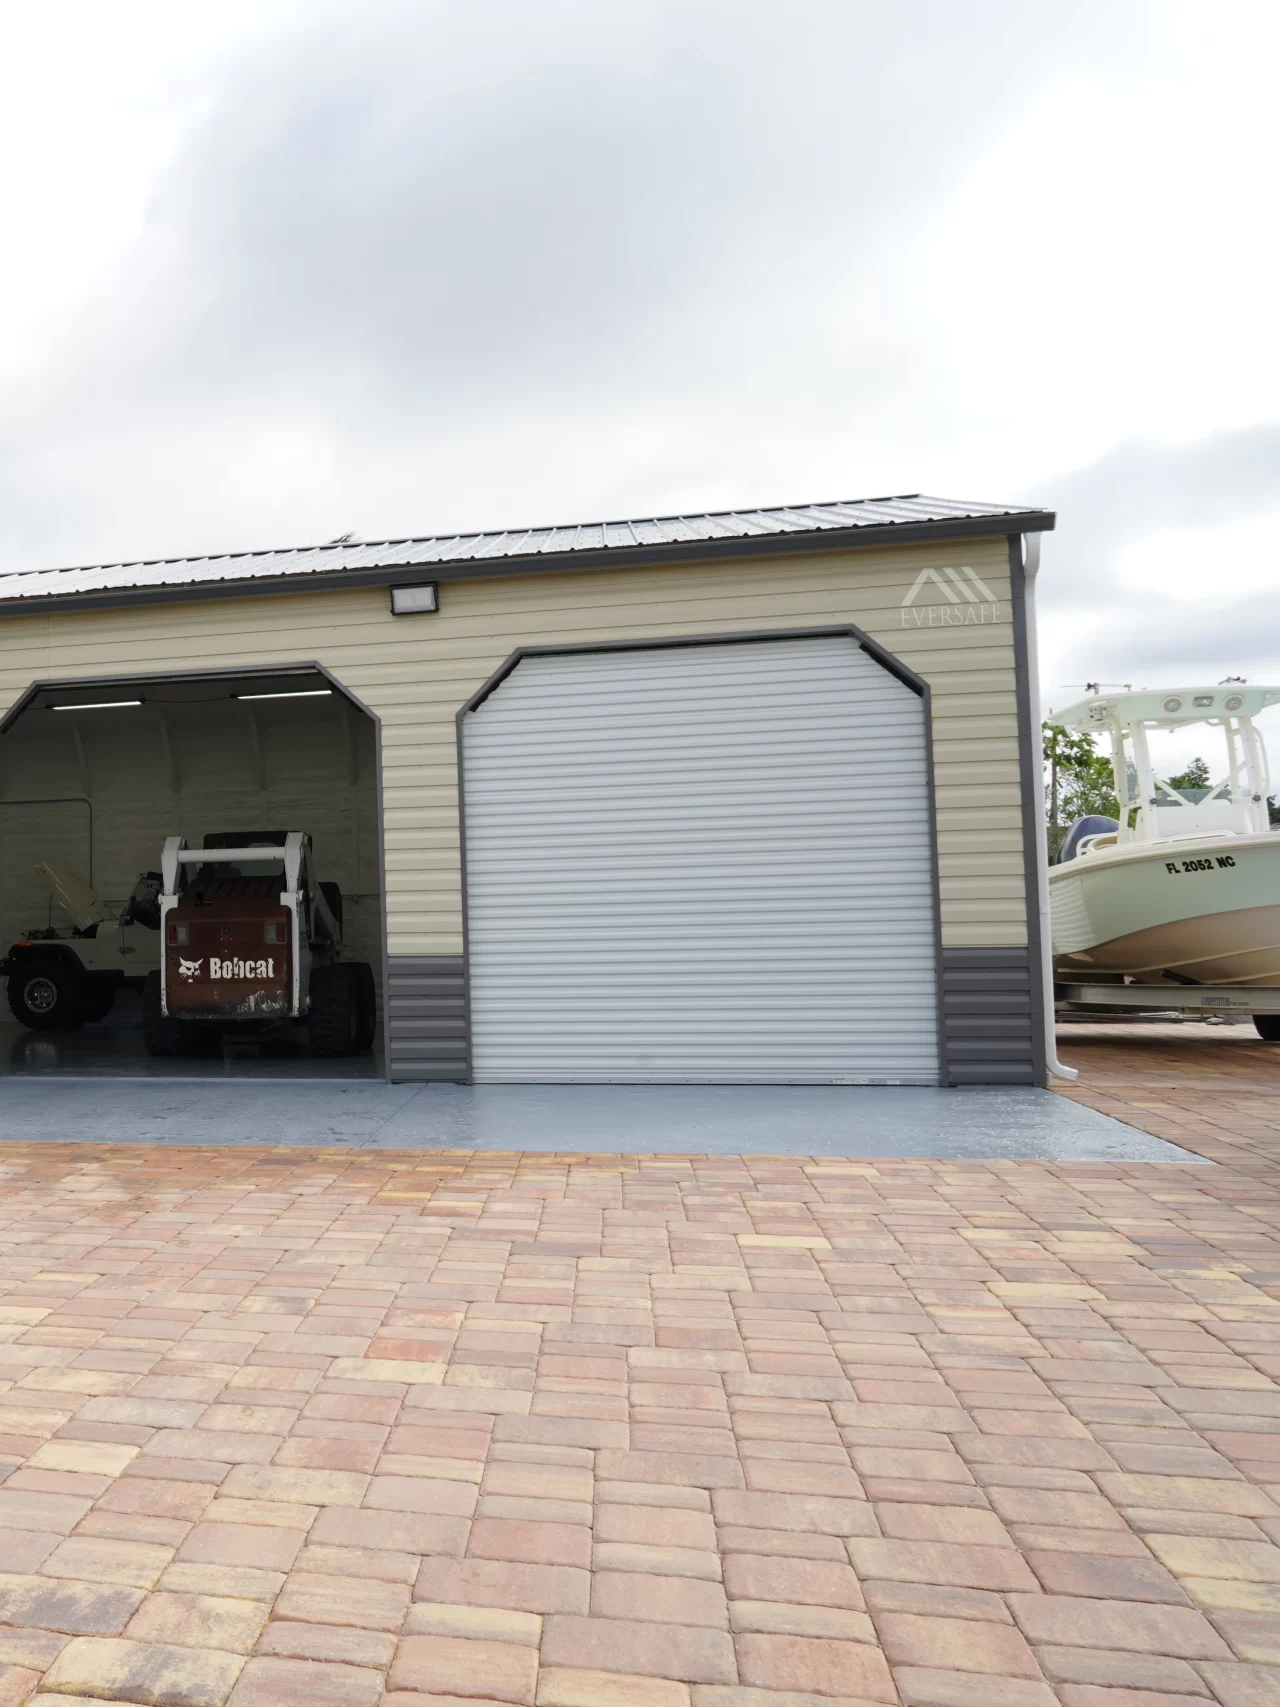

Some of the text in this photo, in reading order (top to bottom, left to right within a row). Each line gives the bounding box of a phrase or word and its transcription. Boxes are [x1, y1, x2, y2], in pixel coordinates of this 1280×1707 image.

[1165, 856, 1236, 874] FL 2052 NC
[210, 957, 274, 979] Bobcat
